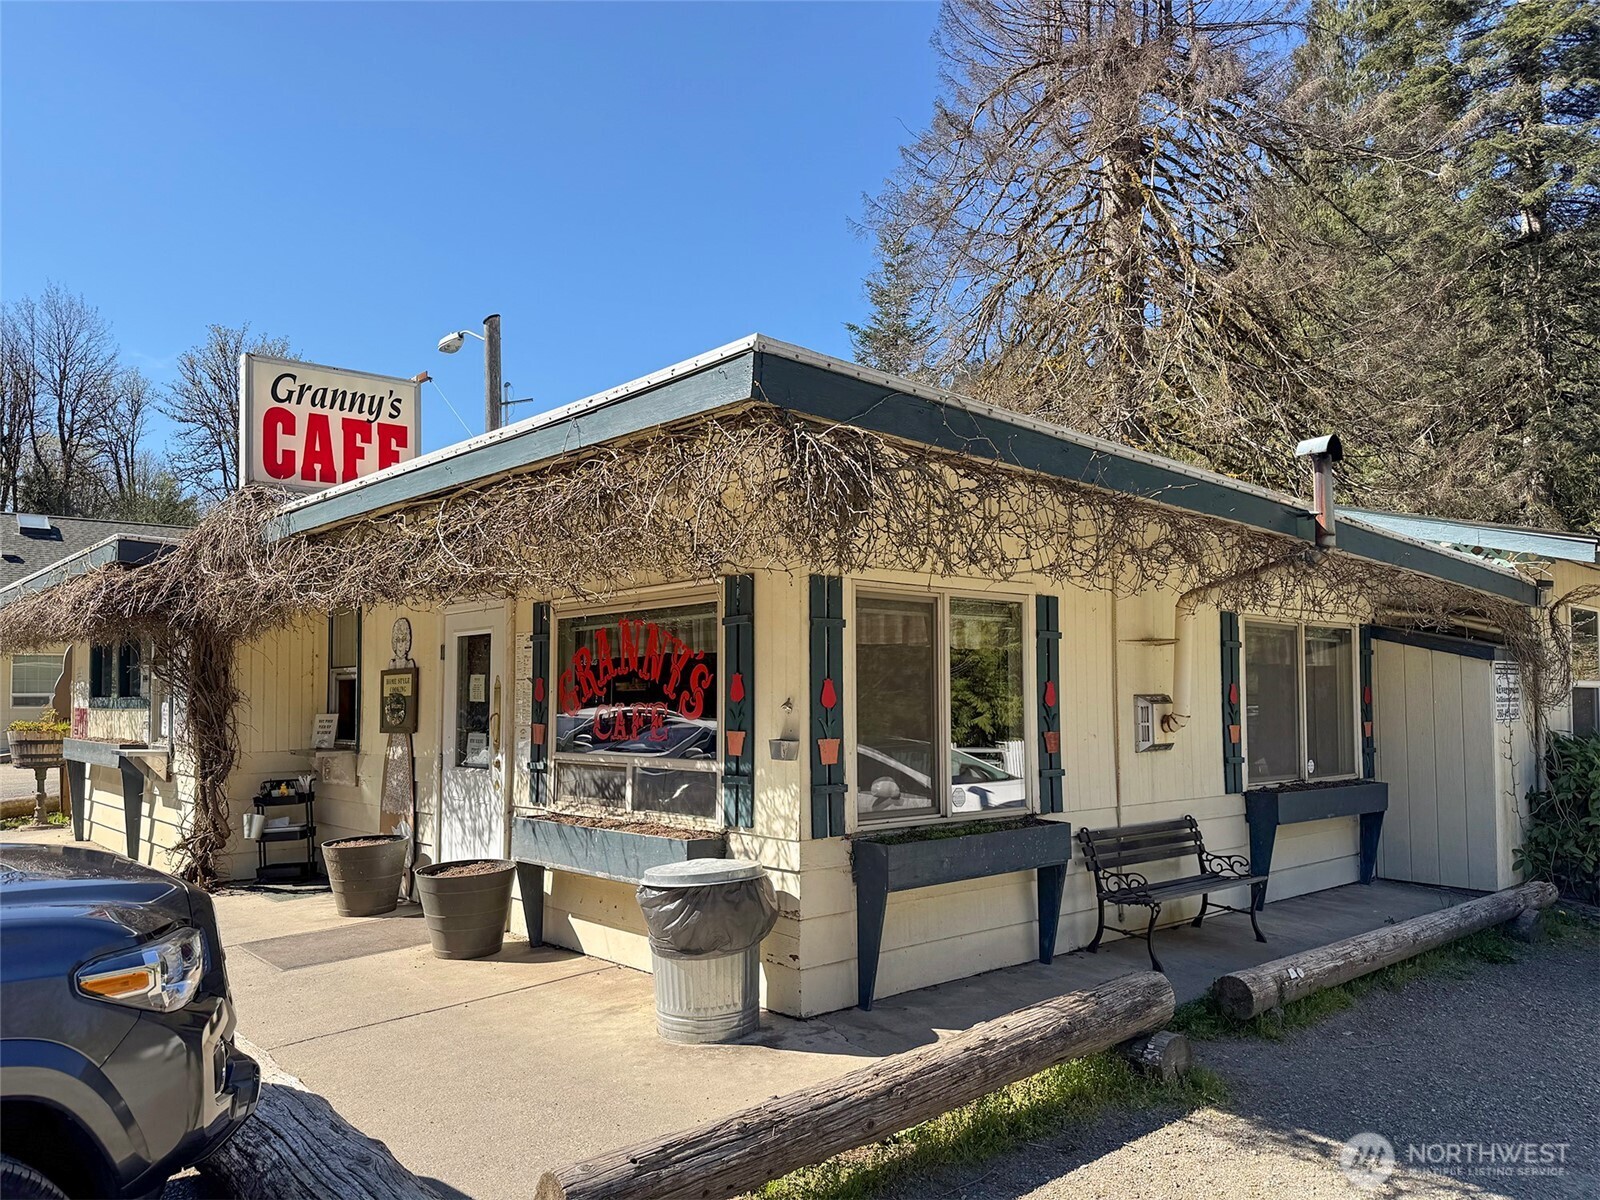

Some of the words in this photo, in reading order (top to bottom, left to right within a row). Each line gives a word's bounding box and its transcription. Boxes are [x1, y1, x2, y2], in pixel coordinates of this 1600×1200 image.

[270, 373, 403, 424] Granny's
[262, 406, 408, 484] CAFE
[559, 618, 714, 721] GRANNY'S
[593, 701, 669, 742] CAFE
